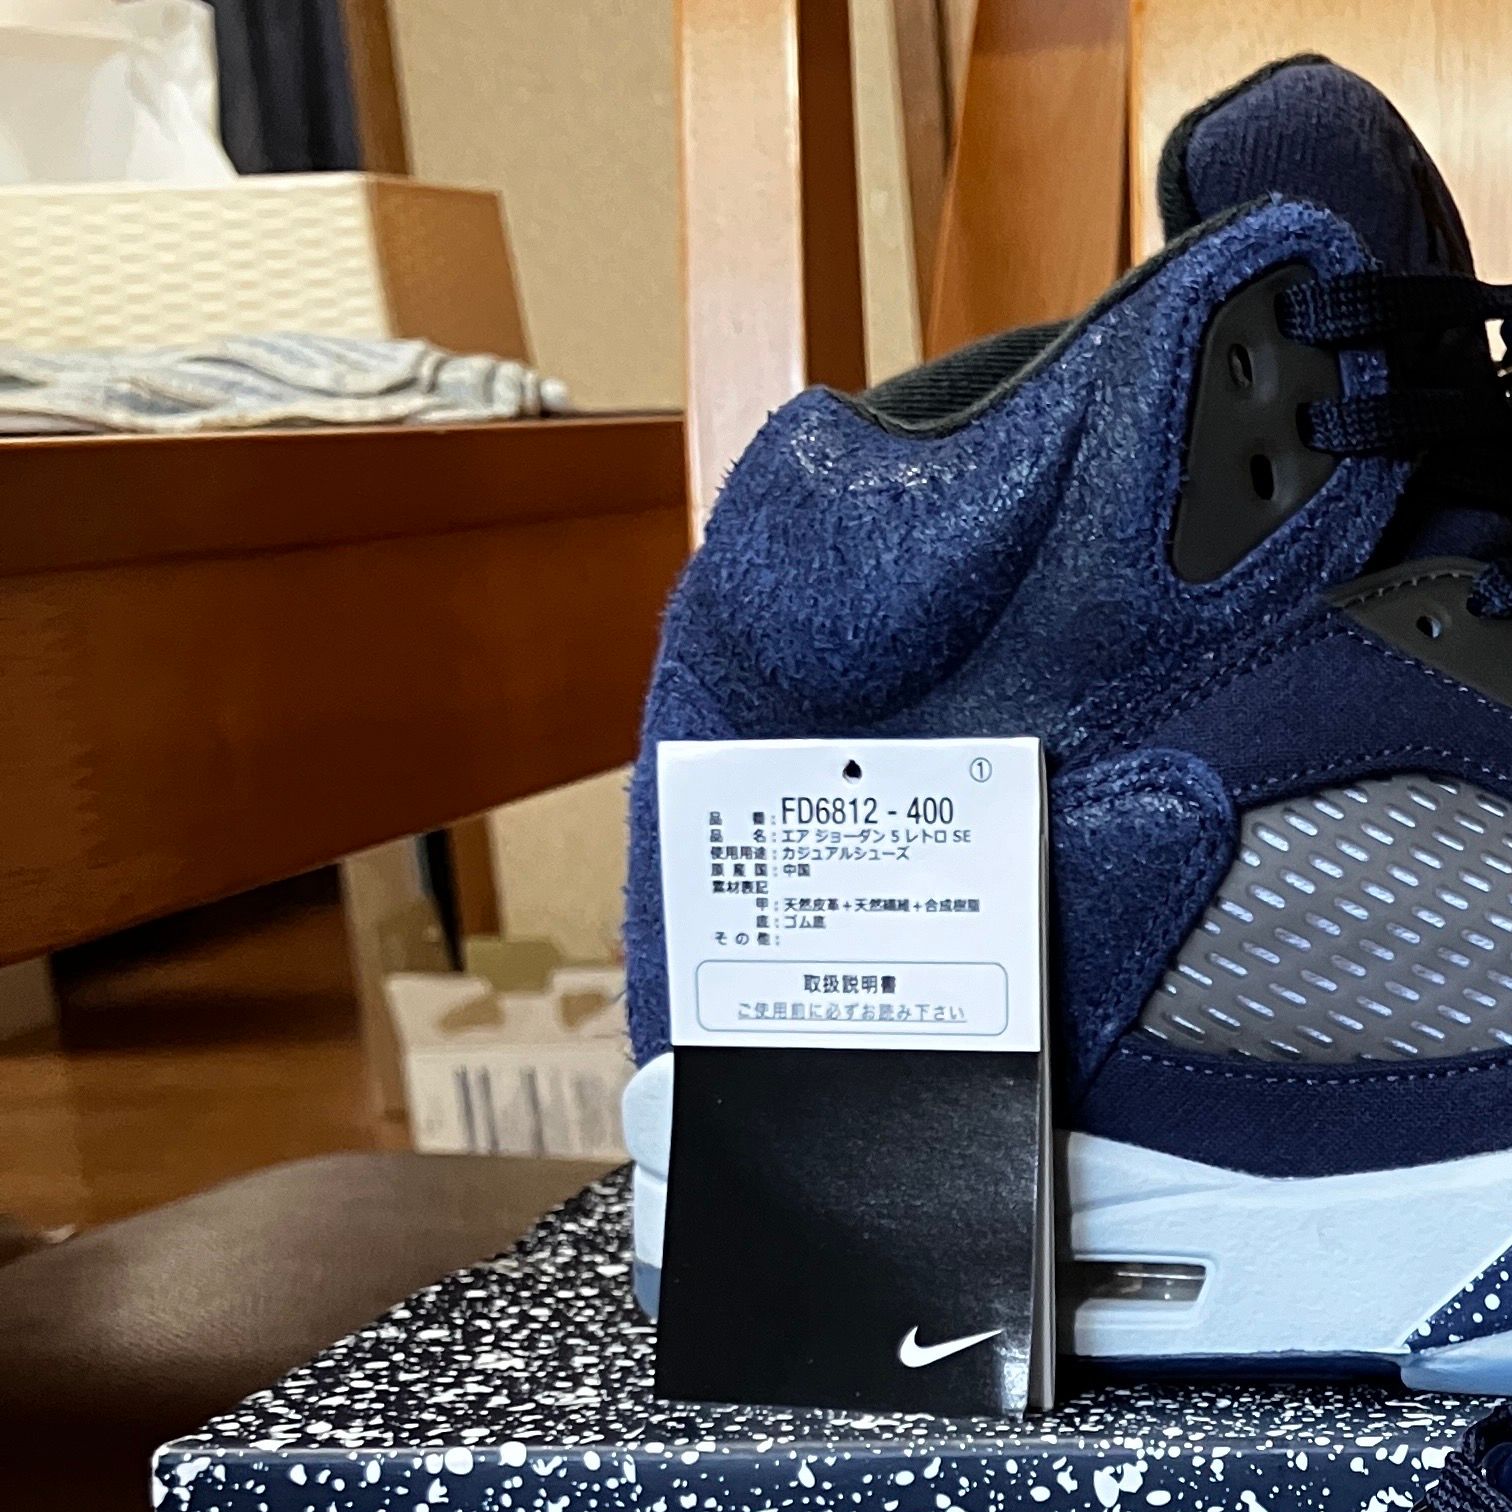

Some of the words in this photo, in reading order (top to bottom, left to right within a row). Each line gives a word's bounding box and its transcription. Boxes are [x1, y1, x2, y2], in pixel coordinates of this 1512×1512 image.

[781, 797, 878, 825] FD6812
[906, 797, 954, 825] 400
[782, 830, 809, 843] エア
[816, 829, 885, 843] ジョーダン
[891, 830, 899, 843] 5
[905, 830, 947, 843] レトロ
[953, 830, 971, 843] SE
[803, 974, 896, 994] 取扱説明書
